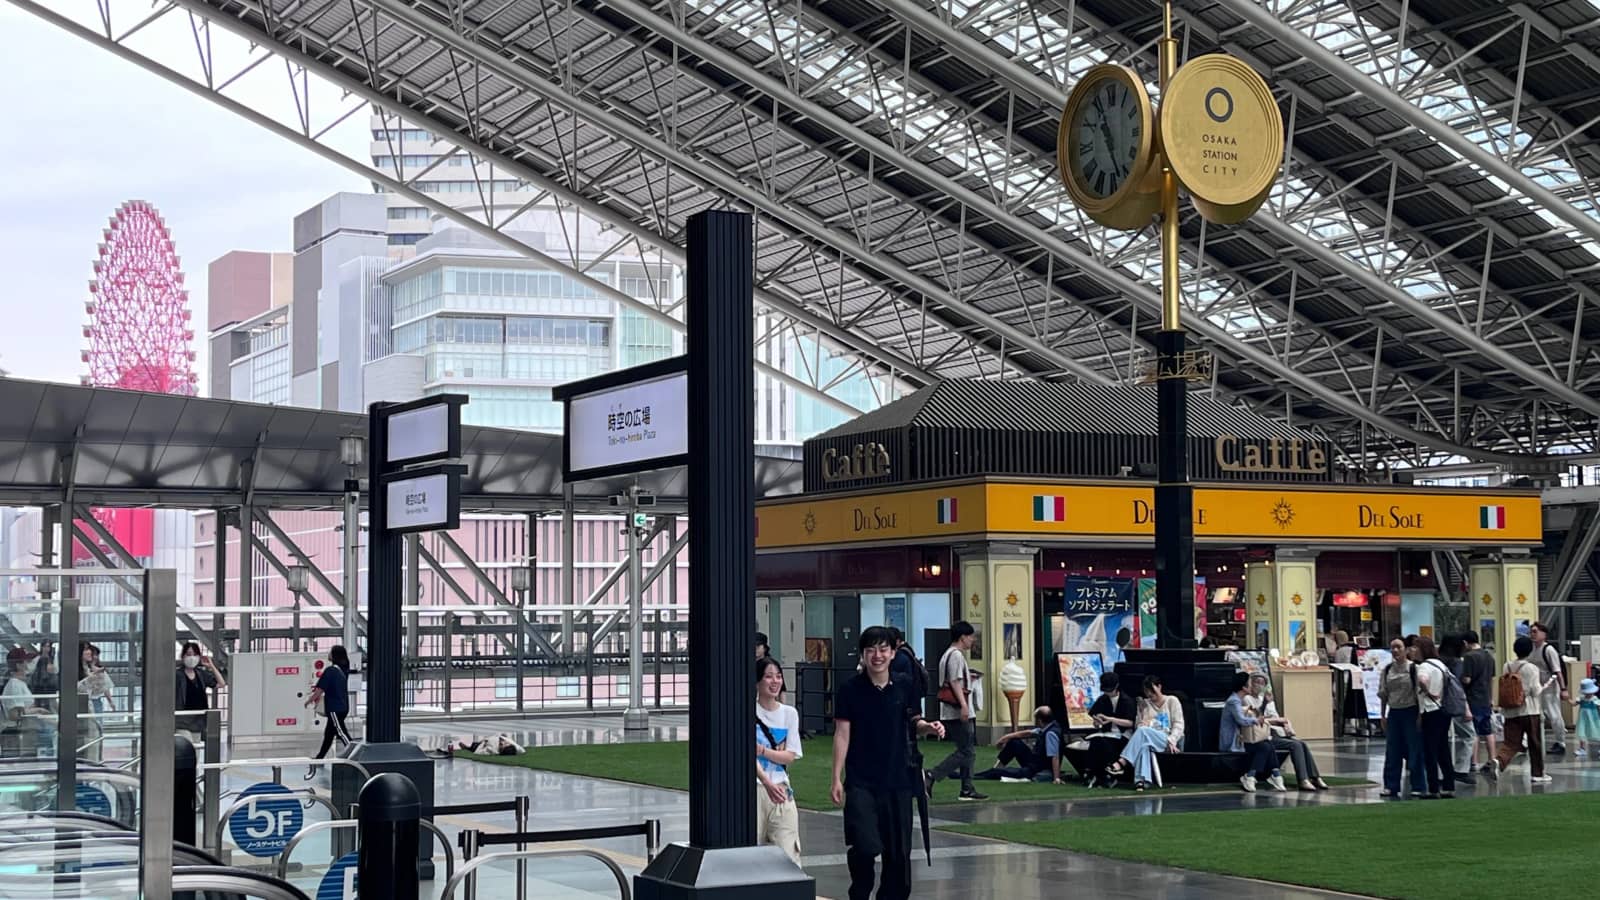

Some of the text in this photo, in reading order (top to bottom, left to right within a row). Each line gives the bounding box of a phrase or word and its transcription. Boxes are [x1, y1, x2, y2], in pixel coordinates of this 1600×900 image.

[1202, 134, 1238, 146] OSAKA
[1202, 150, 1238, 161] STATION
[1203, 165, 1237, 176] CITY
[608, 406, 651, 432] 時空の広場
[643, 429, 657, 441] Plaza
[1216, 433, 1327, 474] Caffè
[1076, 586, 1118, 598] プレミアム
[1068, 599, 1131, 612] ソフトジェラート
[246, 798, 293, 839] 5F
